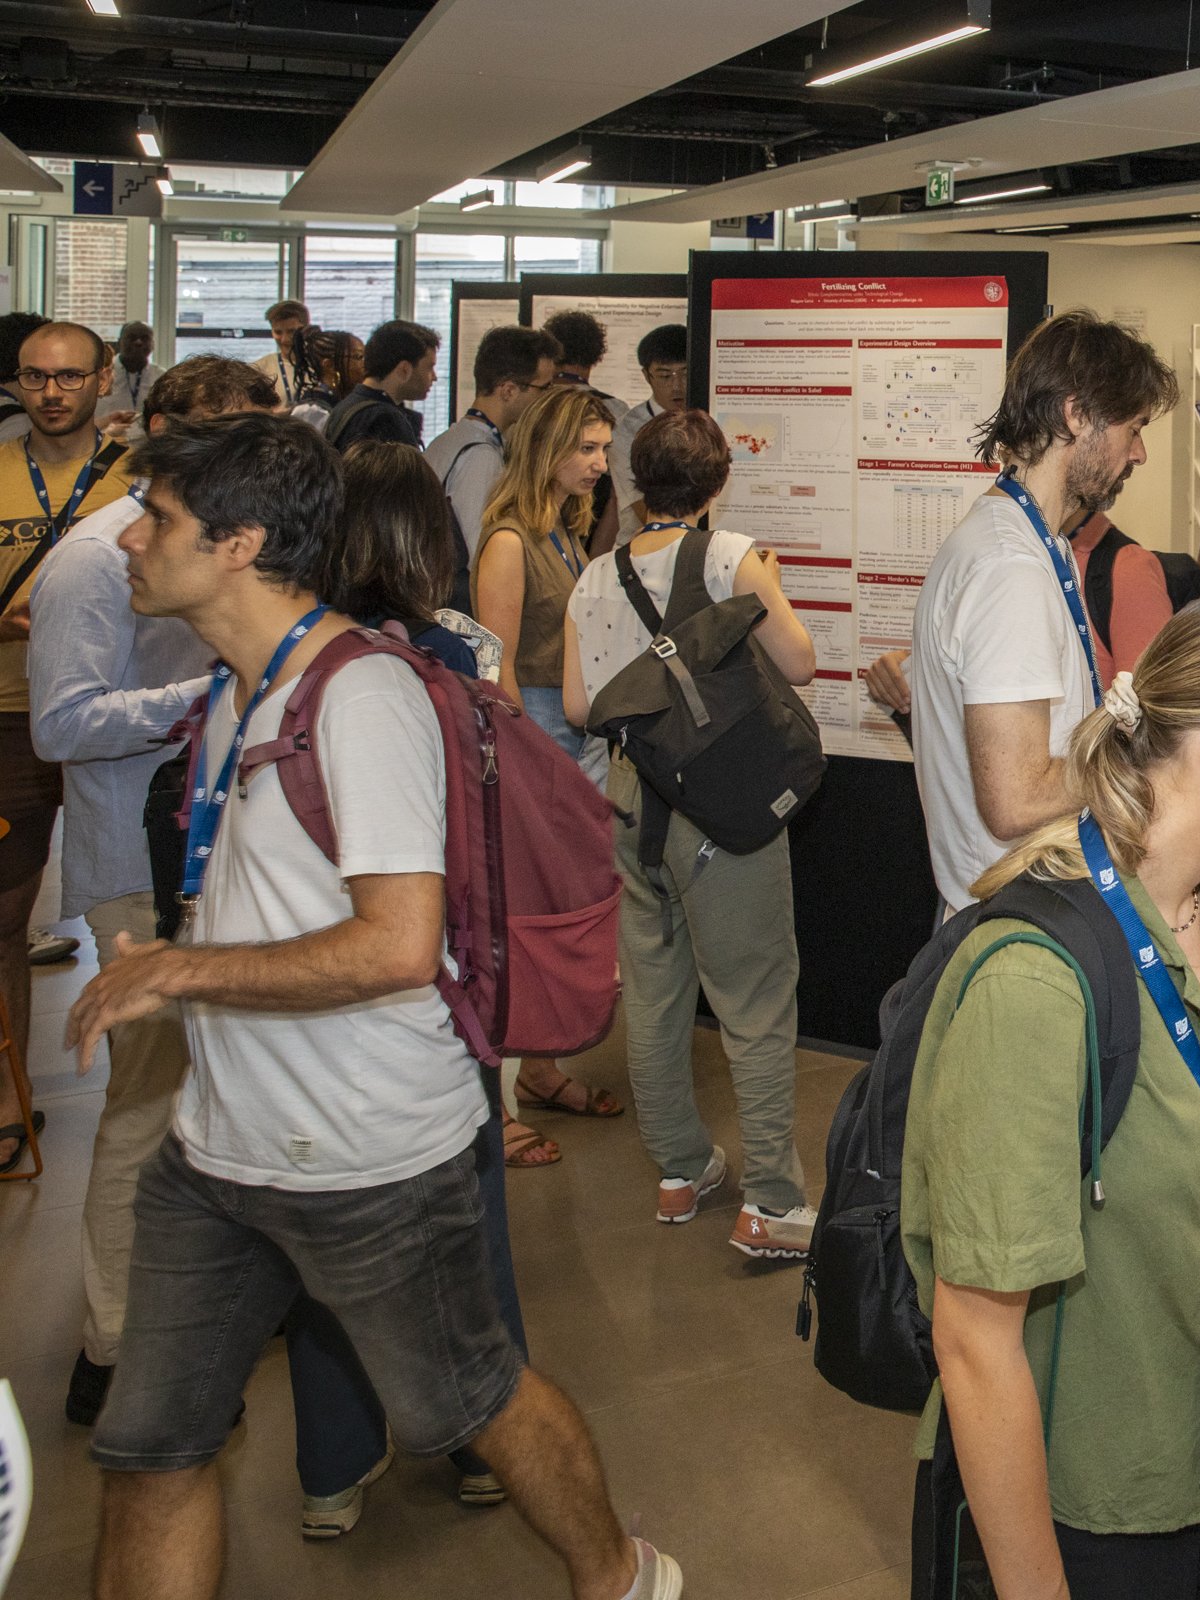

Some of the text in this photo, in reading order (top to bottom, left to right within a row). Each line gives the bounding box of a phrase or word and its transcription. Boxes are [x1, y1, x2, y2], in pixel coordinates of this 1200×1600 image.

[821, 282, 887, 291] Fertilizing Conflict
[860, 340, 893, 348] Experimental
